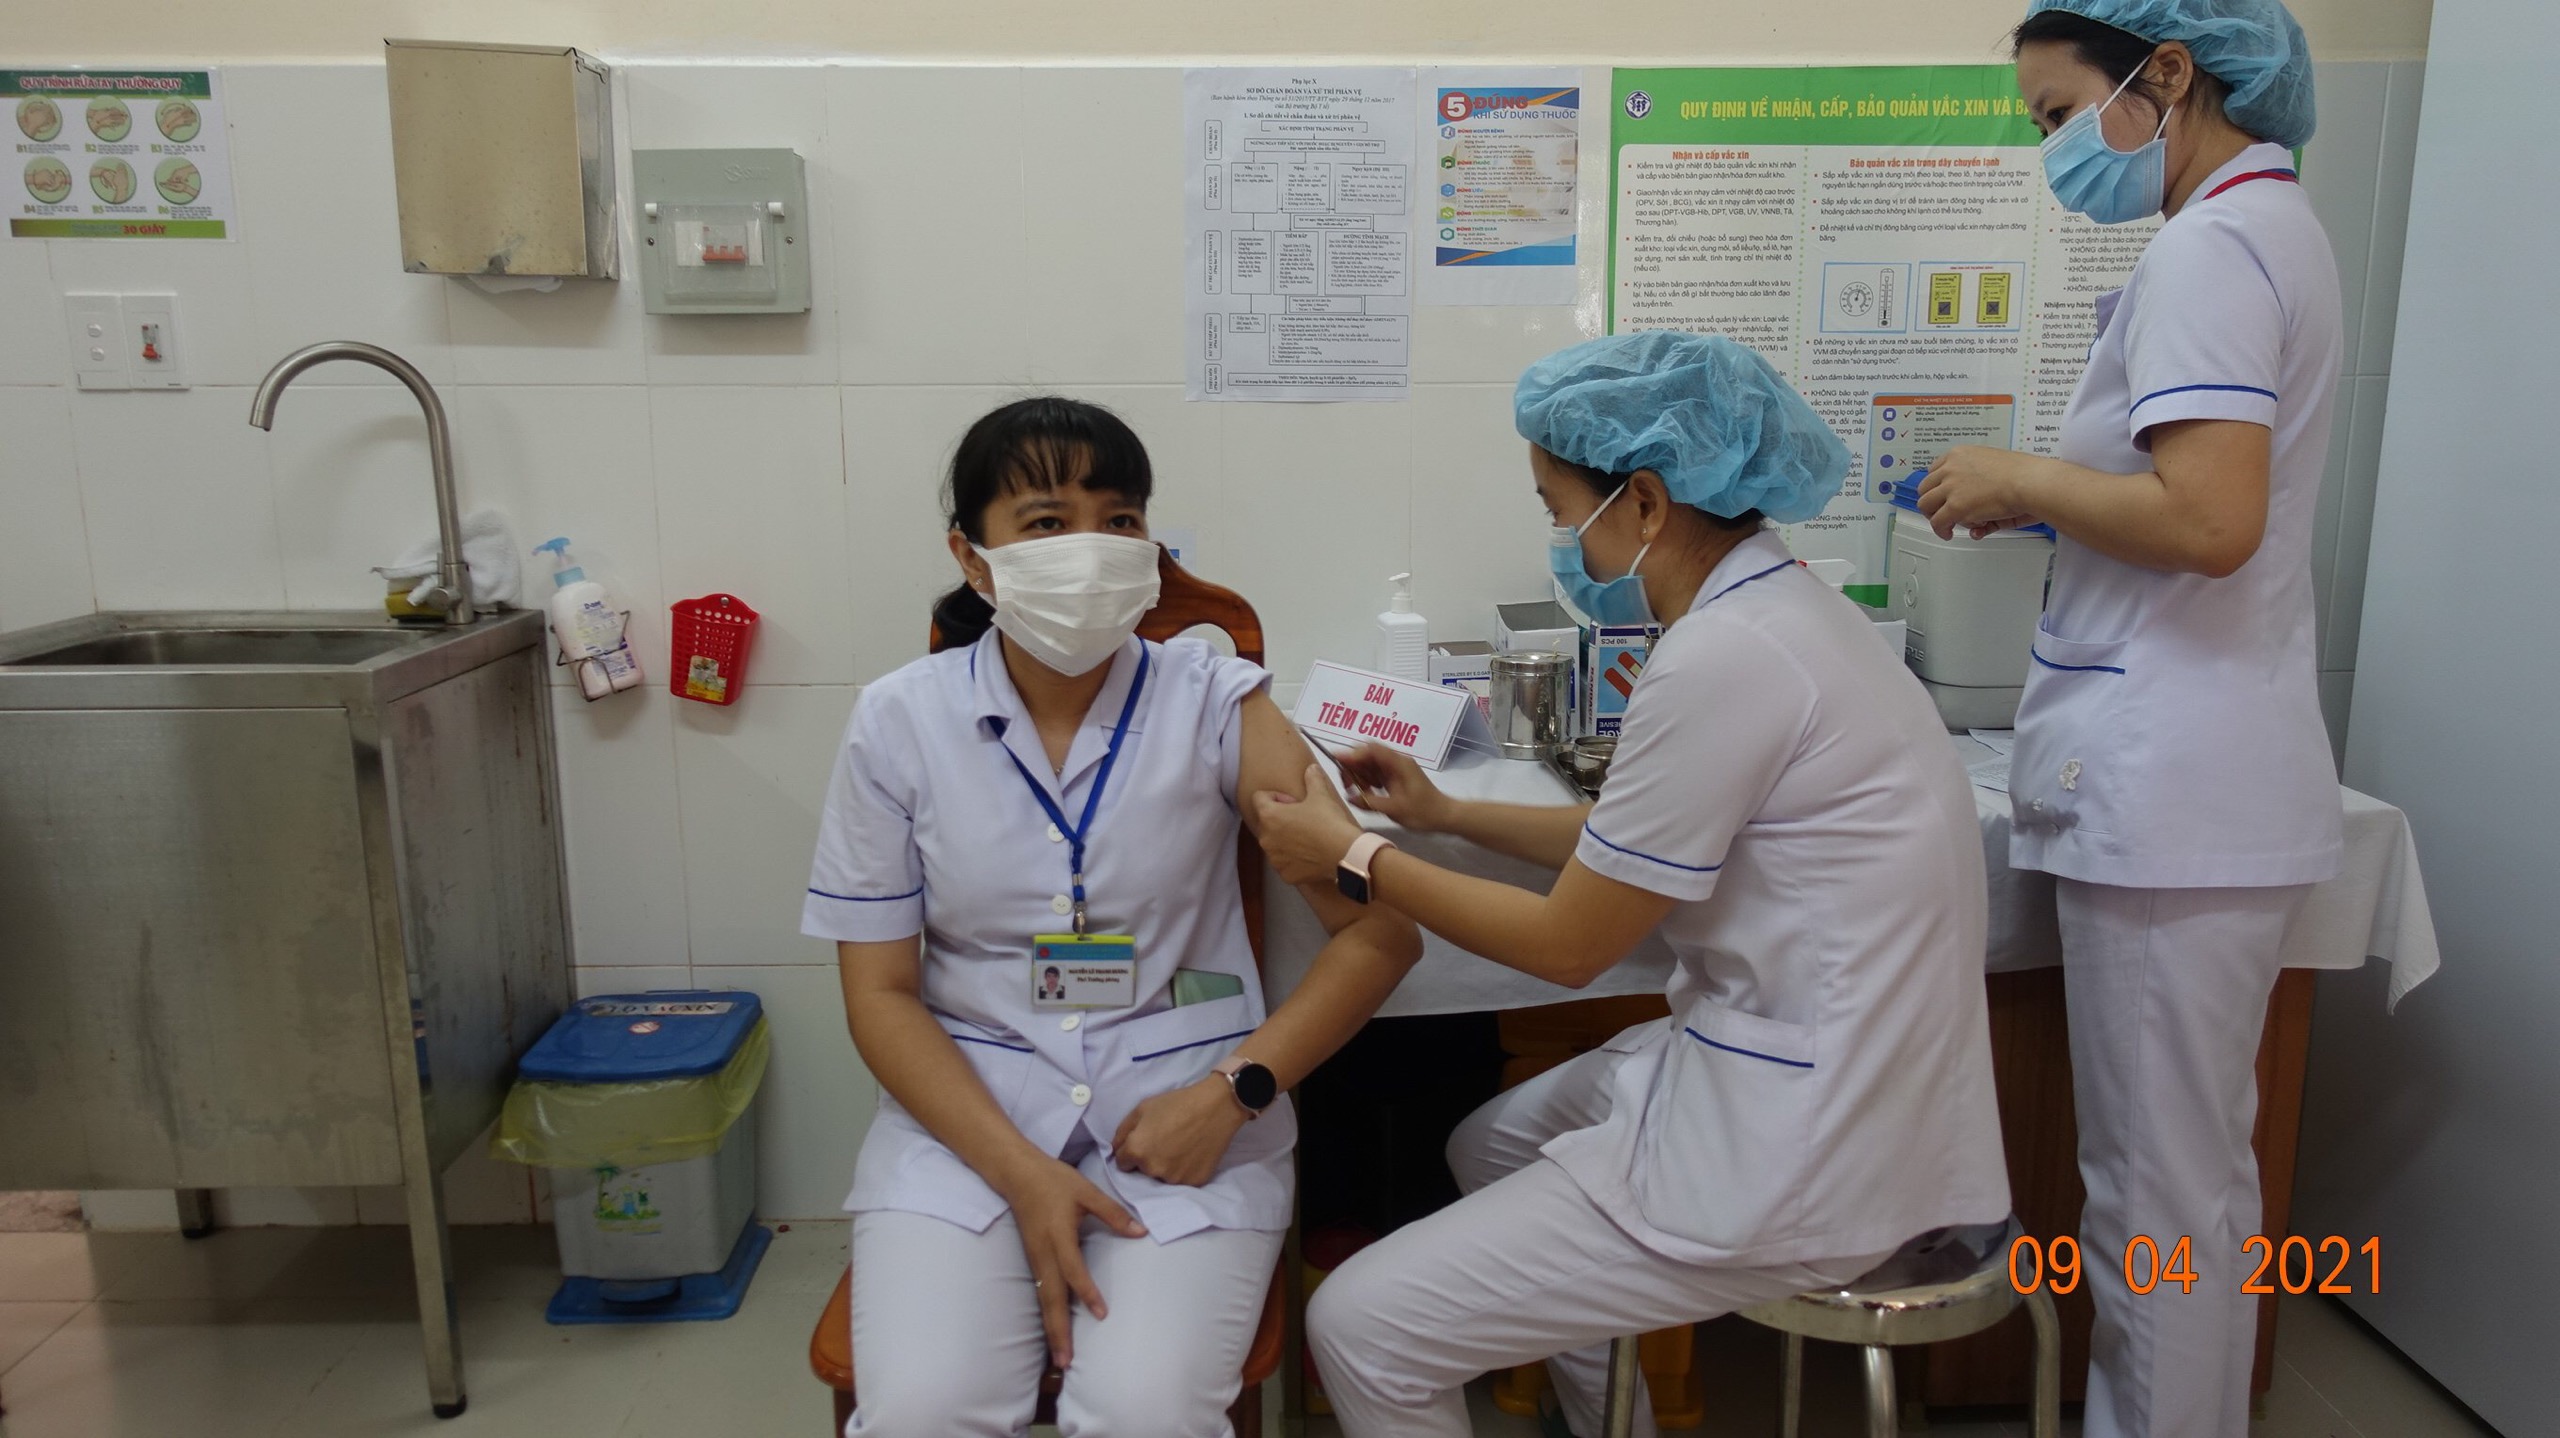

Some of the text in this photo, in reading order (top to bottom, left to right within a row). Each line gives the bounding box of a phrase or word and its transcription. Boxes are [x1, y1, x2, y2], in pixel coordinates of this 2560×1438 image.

[21, 77, 43, 89] QUY
[160, 78, 182, 89] QUY
[1447, 94, 1529, 118] 5 ĐÚNG
[1681, 101, 1708, 119] QUY
[1712, 101, 1747, 120] ĐỊNH
[1751, 98, 1768, 117] VỀ
[1772, 98, 1815, 119] NHẬN,
[1820, 97, 1852, 118] CẤP,
[1857, 96, 1885, 117] BẢO
[1890, 96, 1928, 118] QUẢN
[1933, 95, 1960, 116] VẮC
[1964, 99, 1989, 116] XIN
[1993, 96, 2011, 116] VÀ
[1473, 109, 1576, 120] KHI SỬ DỤNG THUỐC
[1673, 150, 1749, 161] Nhận và cấp vắc xin
[1727, 162, 1744, 170] quản
[1780, 161, 1796, 169] nhận
[1850, 158, 1865, 168] Bảo
[1866, 158, 1885, 168] quản
[1887, 158, 1901, 168] vắc
[1903, 158, 1915, 167] xin
[1917, 159, 1936, 168] trong
[1938, 158, 1952, 168] dây
[1954, 157, 1981, 168] chuyền
[1851, 170, 1863, 178] vắc
[122, 225, 138, 234] 30
[140, 224, 166, 234] GIÂY
[1986, 336, 1997, 344] vắc
[1811, 389, 1837, 397] KHÔNG
[1363, 682, 1395, 707] BÀN
[1317, 701, 1420, 747] TIÊM CHỦNG
